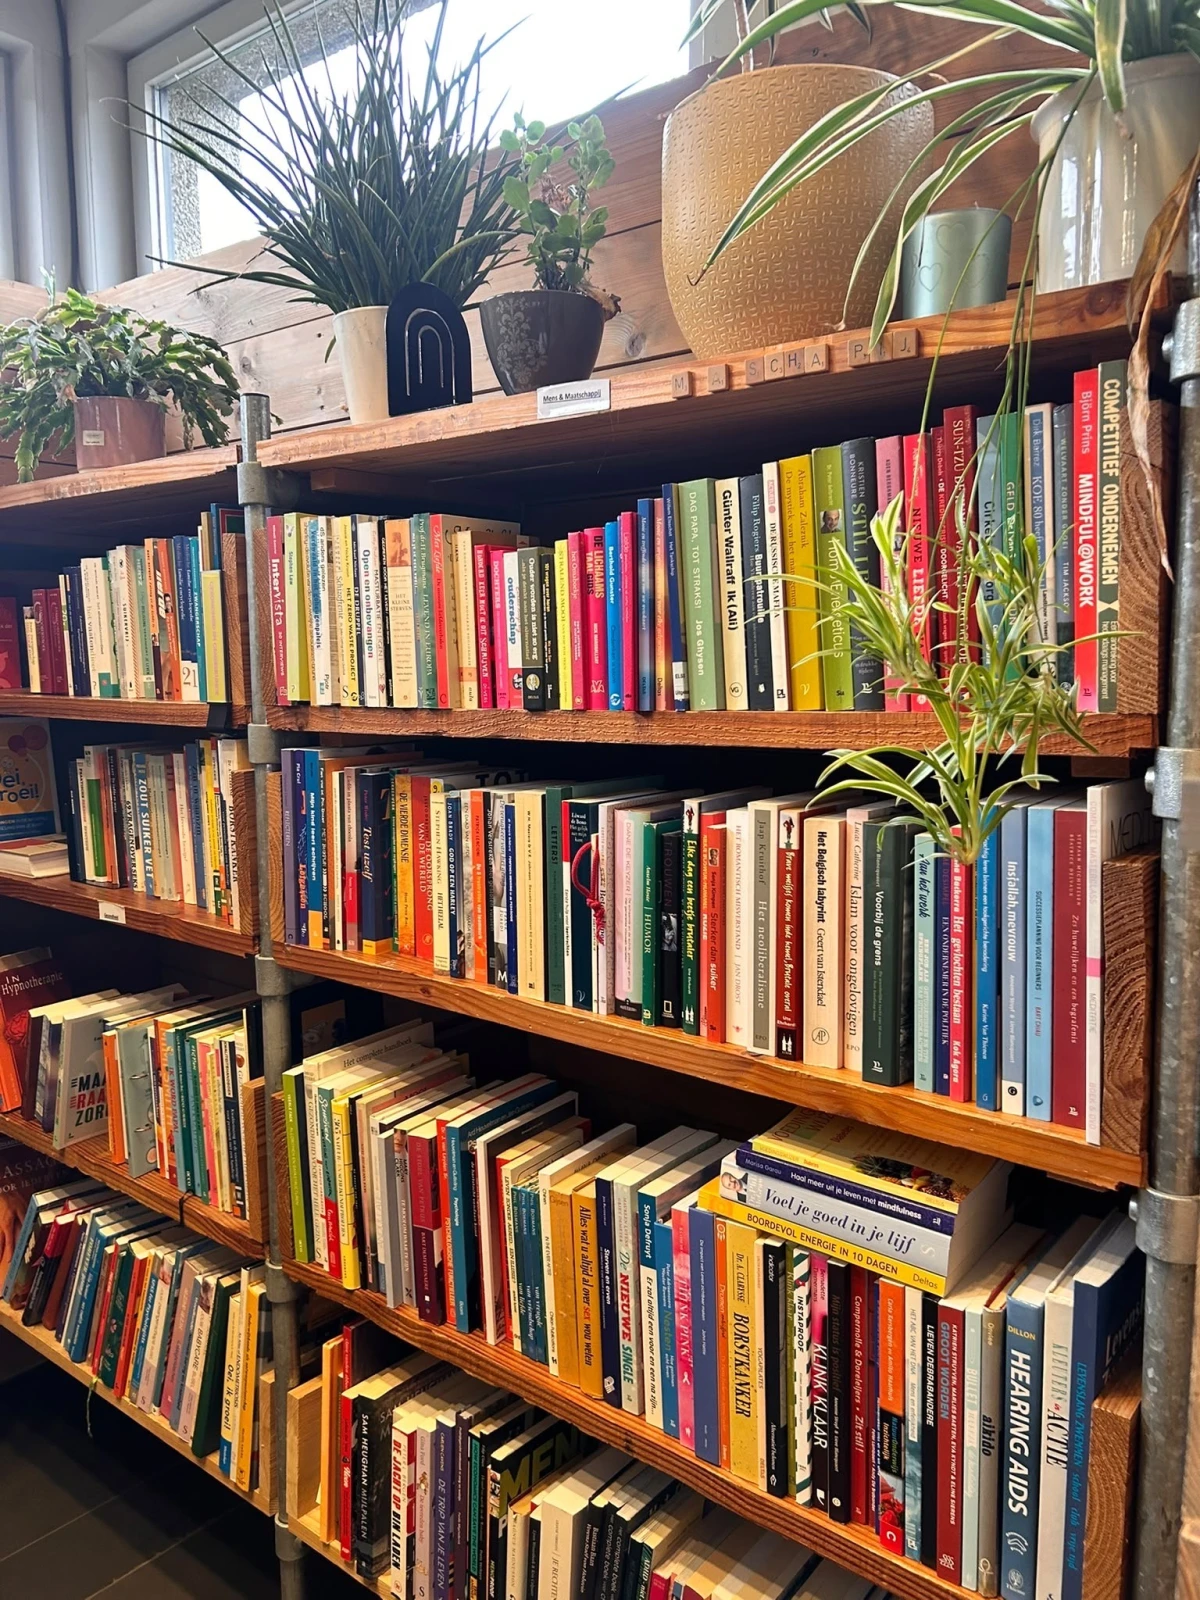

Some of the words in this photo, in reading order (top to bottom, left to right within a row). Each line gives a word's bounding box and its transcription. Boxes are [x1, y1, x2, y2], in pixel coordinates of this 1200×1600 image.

[543, 394, 558, 403] Mens
[565, 388, 601, 401] Maatschappij
[1079, 390, 1095, 422] Björn
[1081, 424, 1094, 454] Prins
[1102, 378, 1120, 477] COMPETITIEF
[797, 469, 807, 508] Abraham
[849, 454, 859, 499] BONNEURE
[856, 461, 866, 497] KRISTIEN
[689, 492, 698, 512] DAG
[721, 490, 734, 534] Günter
[689, 516, 699, 543] PAPA,
[799, 512, 809, 549] Zaleznik
[1076, 473, 1095, 607] MINDFUL@WORK
[1102, 484, 1119, 584] ONDERNEMEN
[361, 550, 371, 577] Open
[528, 558, 536, 582] Ouder
[692, 546, 700, 564] TOT
[724, 536, 737, 585] Wallraff
[271, 557, 284, 626] Intervista
[363, 579, 370, 592] en
[530, 583, 538, 611] worden
[693, 568, 702, 609] STRAKS!
[727, 590, 737, 603] Ik
[507, 577, 517, 644] ouderschap
[726, 604, 739, 631] (Ali)
[365, 595, 374, 659] onbevangen
[531, 620, 539, 636] niet
[532, 637, 538, 646] zo
[695, 620, 705, 636] Jos
[531, 647, 539, 660] erg
[695, 640, 706, 676] Ghysen
[126, 800, 132, 810] 69
[138, 779, 148, 807] ZOUT
[400, 792, 409, 802] DE
[126, 811, 136, 848] VRAGEN
[400, 804, 409, 828] VIERDE
[757, 820, 767, 839] Jaap
[142, 812, 151, 854] SUIKER
[362, 826, 372, 849] Test
[400, 829, 410, 863] DIMENSIE
[818, 831, 827, 848] Het
[129, 848, 137, 868] OVER
[145, 859, 154, 879] VET
[361, 853, 374, 882] uzelf
[758, 844, 767, 885] Kruithof
[815, 849, 828, 885] Belgisch
[131, 869, 139, 888] SEKS
[664, 842, 672, 907] TROUWEN
[758, 901, 767, 922] Het
[816, 887, 828, 923] labyrint
[849, 885, 862, 918] Islam
[873, 891, 884, 923] Voorbij
[644, 914, 652, 953] HUMOR
[710, 912, 718, 944] Sterker
[850, 924, 860, 953] voor
[875, 926, 885, 937] de
[952, 915, 964, 932] Het
[710, 945, 718, 961] dan
[817, 928, 827, 950] Geert
[873, 940, 882, 966] grens
[757, 926, 768, 1008] neoliberalisme
[817, 953, 825, 968] van
[951, 937, 966, 986] gevlochten
[1, 970, 63, 996] Hypnotherapie
[817, 969, 827, 1007] Istendael
[846, 958, 860, 1037] ongelovigen
[953, 988, 964, 1024] bestaan
[791, 1172, 806, 1184] Haal
[808, 1178, 824, 1189] meer
[826, 1180, 835, 1191] uit
[835, 1183, 843, 1195] je
[844, 1186, 862, 1199] leven
[862, 1193, 877, 1204] met
[878, 1196, 922, 1221] mindfulness
[578, 1206, 591, 1227] Alles
[642, 1203, 652, 1226] Sonja
[765, 1188, 794, 1212] Voel
[796, 1198, 810, 1217] je
[812, 1203, 848, 1231] goed
[851, 1218, 866, 1236] in
[867, 1224, 884, 1244] je
[887, 1231, 916, 1255] lijf
[580, 1228, 591, 1244] wat
[643, 1228, 653, 1258] Defruyt
[579, 1252, 593, 1275] altijd
[619, 1252, 630, 1270] De
[747, 1213, 798, 1240] BOORDEVOL
[800, 1232, 837, 1254] ENERGIE
[840, 1246, 849, 1257] IN
[852, 1250, 864, 1262] 10
[866, 1255, 899, 1276] DAGEN
[913, 1272, 939, 1290] Deltas
[582, 1277, 592, 1285] al
[583, 1286, 591, 1304] over
[736, 1272, 745, 1302] CLARYSSE
[582, 1306, 591, 1319] sex
[619, 1272, 631, 1342] NIEUWE
[853, 1296, 863, 1348] Compernolle
[584, 1322, 592, 1339] wou
[925, 1324, 934, 1355] LIEVEN
[940, 1321, 949, 1364] GROOT
[1007, 1325, 1036, 1341] DILLON
[192, 1328, 204, 1371] BABYCARE
[584, 1341, 594, 1365] weten
[621, 1344, 633, 1385] SINGLE
[224, 1364, 234, 1383] Oei,
[733, 1312, 750, 1418] BORSTKANKER
[812, 1342, 827, 1390] KLINK
[1051, 1343, 1069, 1402] KLEUTERS
[225, 1387, 234, 1397] ik
[854, 1359, 864, 1403] Doreleijers
[926, 1356, 935, 1426] DEBRABANDERE
[940, 1366, 949, 1418] WORDEN
[1073, 1362, 1088, 1418] LEVENSLANG
[222, 1400, 231, 1430] groei!
[1009, 1349, 1031, 1453] HEARING
[360, 1413, 368, 1435] SAM
[813, 1394, 828, 1448] KLAAR
[854, 1415, 863, 1429] Zit
[981, 1414, 996, 1457] aikido
[392, 1440, 402, 1454] DE
[854, 1430, 863, 1445] stil
[1046, 1409, 1070, 1469] ACTIE
[1072, 1420, 1086, 1467] ZWEMMEN
[360, 1438, 369, 1486] HEUGHAN
[392, 1458, 401, 1493] JACHT
[437, 1478, 446, 1495] DE
[1008, 1457, 1029, 1516] AIDS
[1070, 1473, 1083, 1502] school
[360, 1488, 368, 1538] MIJLPALEN
[392, 1495, 401, 1509] OP
[437, 1497, 446, 1519] TRIP
[392, 1510, 401, 1531] BIN
[437, 1520, 446, 1541] VAN
[1069, 1508, 1081, 1527] club
[392, 1533, 401, 1570] LADEN
[437, 1543, 446, 1555] JE
[1067, 1533, 1079, 1551] vrije
[437, 1557, 446, 1589] LEVEN
[1067, 1554, 1079, 1570] tijd
